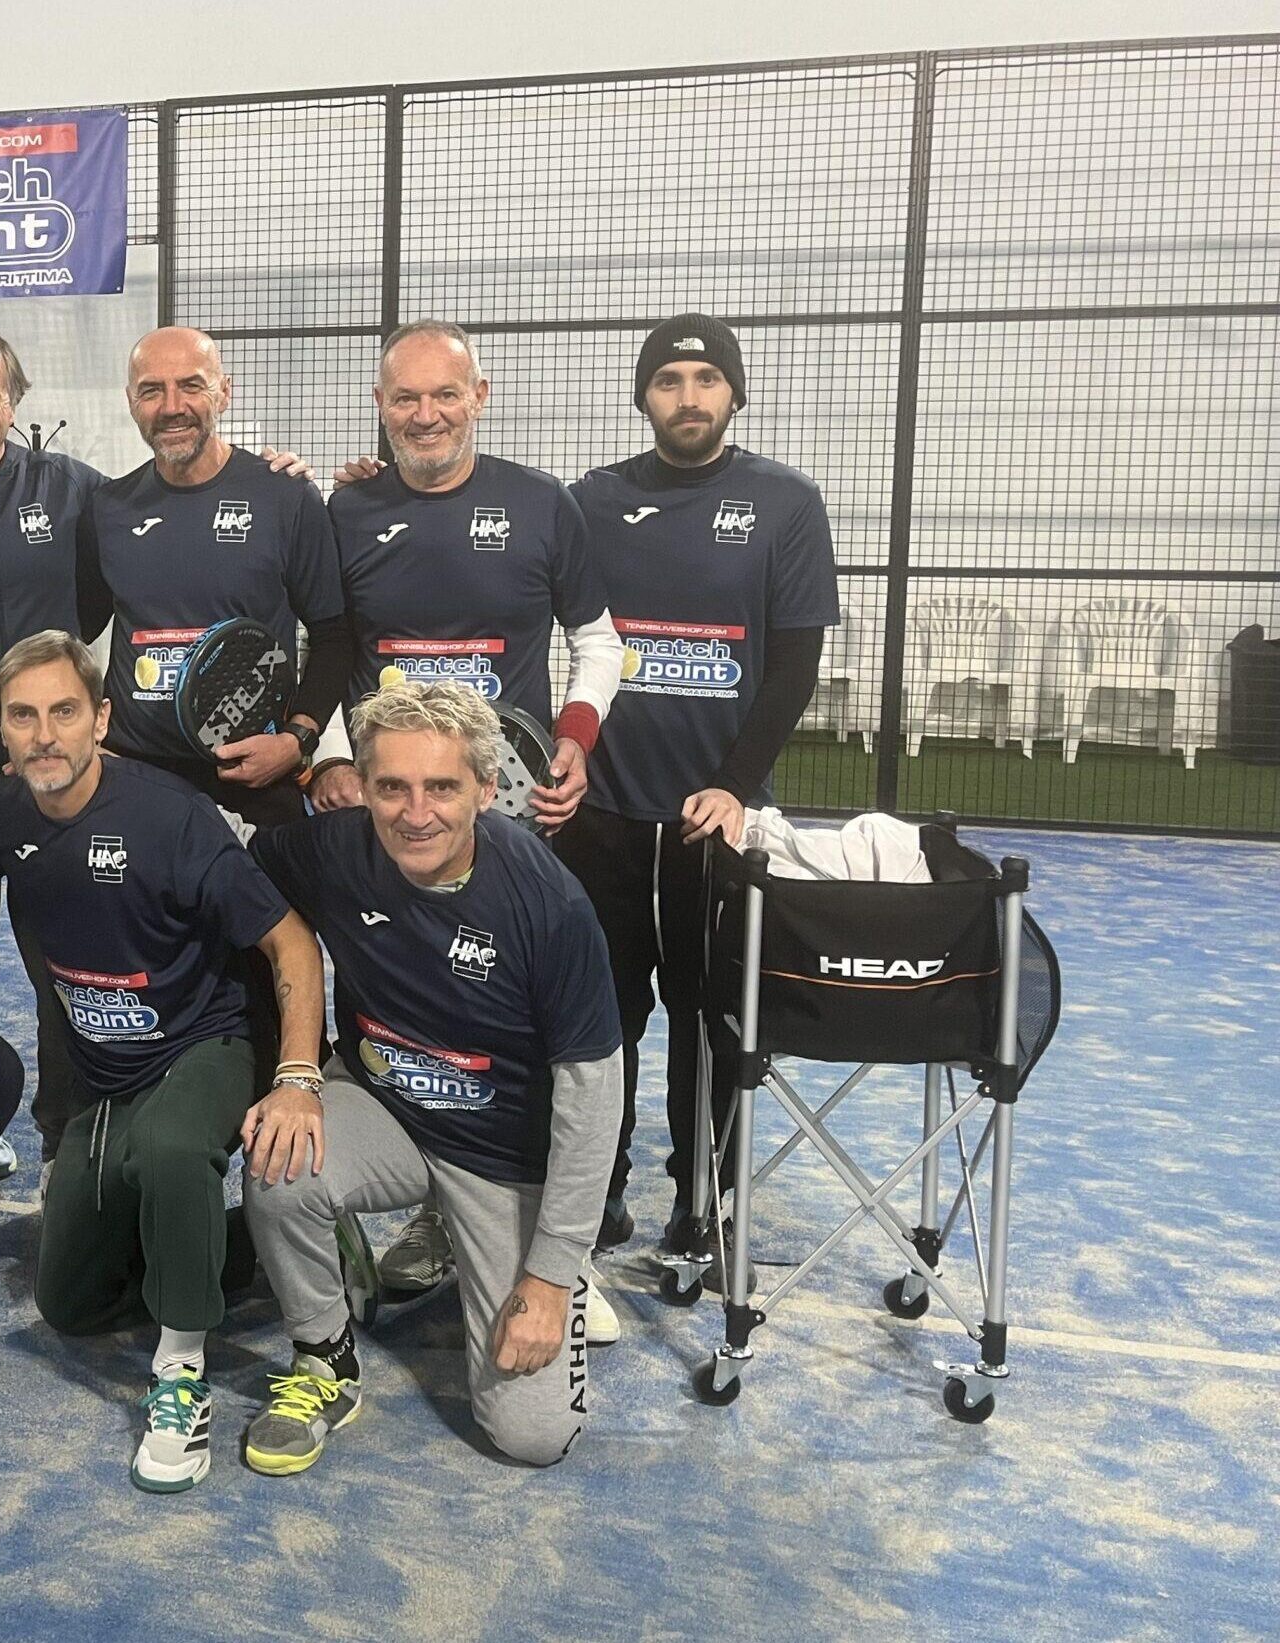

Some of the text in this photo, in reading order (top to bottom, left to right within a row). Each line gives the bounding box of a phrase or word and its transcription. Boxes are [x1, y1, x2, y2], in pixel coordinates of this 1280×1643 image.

[213, 513, 252, 531] HAC
[470, 519, 510, 538] HAC
[712, 512, 756, 532] HAC
[624, 622, 727, 635] TENNISLIVESHOP.COM
[391, 642, 488, 651] TENNISLIVESHOP.COM
[626, 638, 730, 659] match
[394, 654, 491, 675] match
[645, 661, 727, 681] point
[88, 848, 128, 870] HAC
[448, 938, 496, 967] HAC
[820, 955, 946, 979] HEAD
[73, 1006, 145, 1028] point
